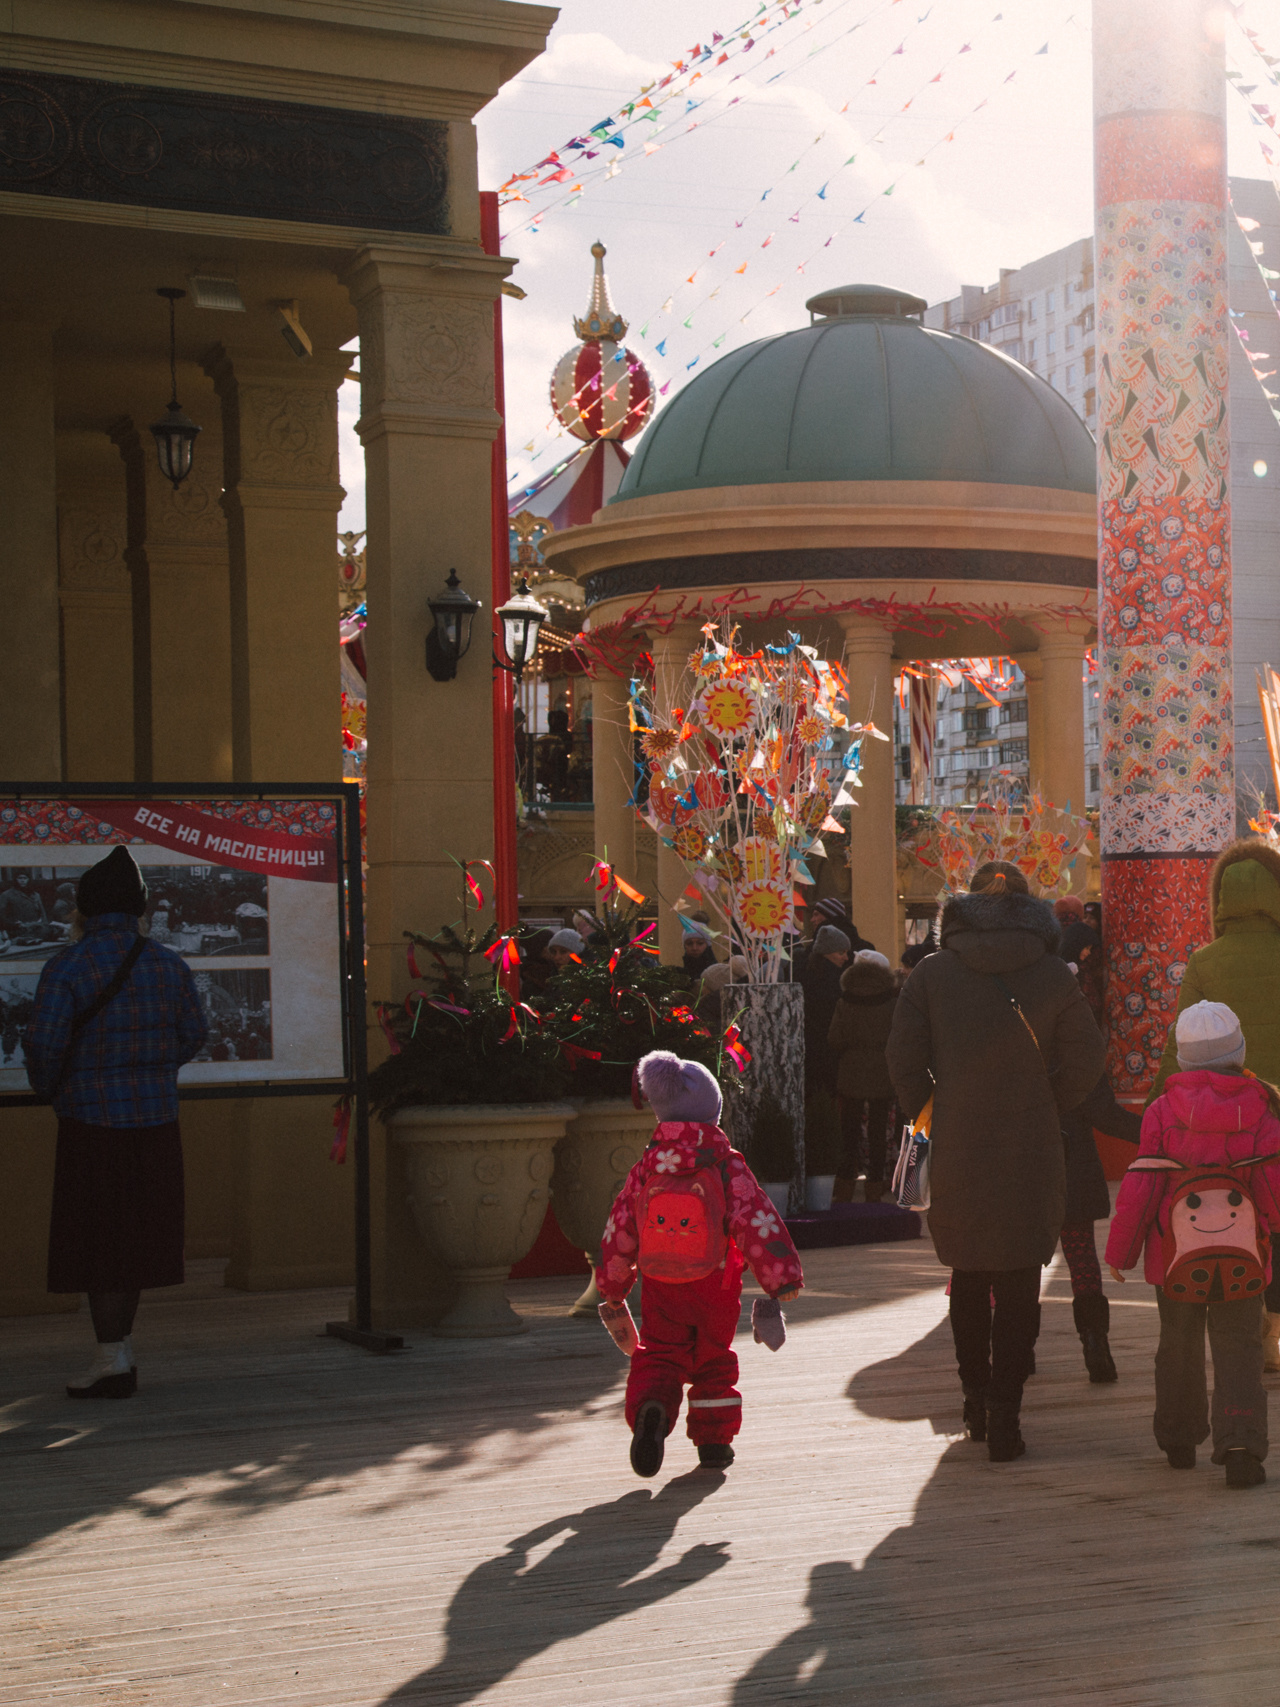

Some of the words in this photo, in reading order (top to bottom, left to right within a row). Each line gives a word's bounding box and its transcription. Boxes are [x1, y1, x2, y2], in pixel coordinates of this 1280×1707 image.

[134, 807, 173, 835] ВСЕ
[175, 824, 201, 846] НА
[204, 834, 326, 867] МАСЛЕНИЦУ!
[908, 1144, 919, 1167] VISA
